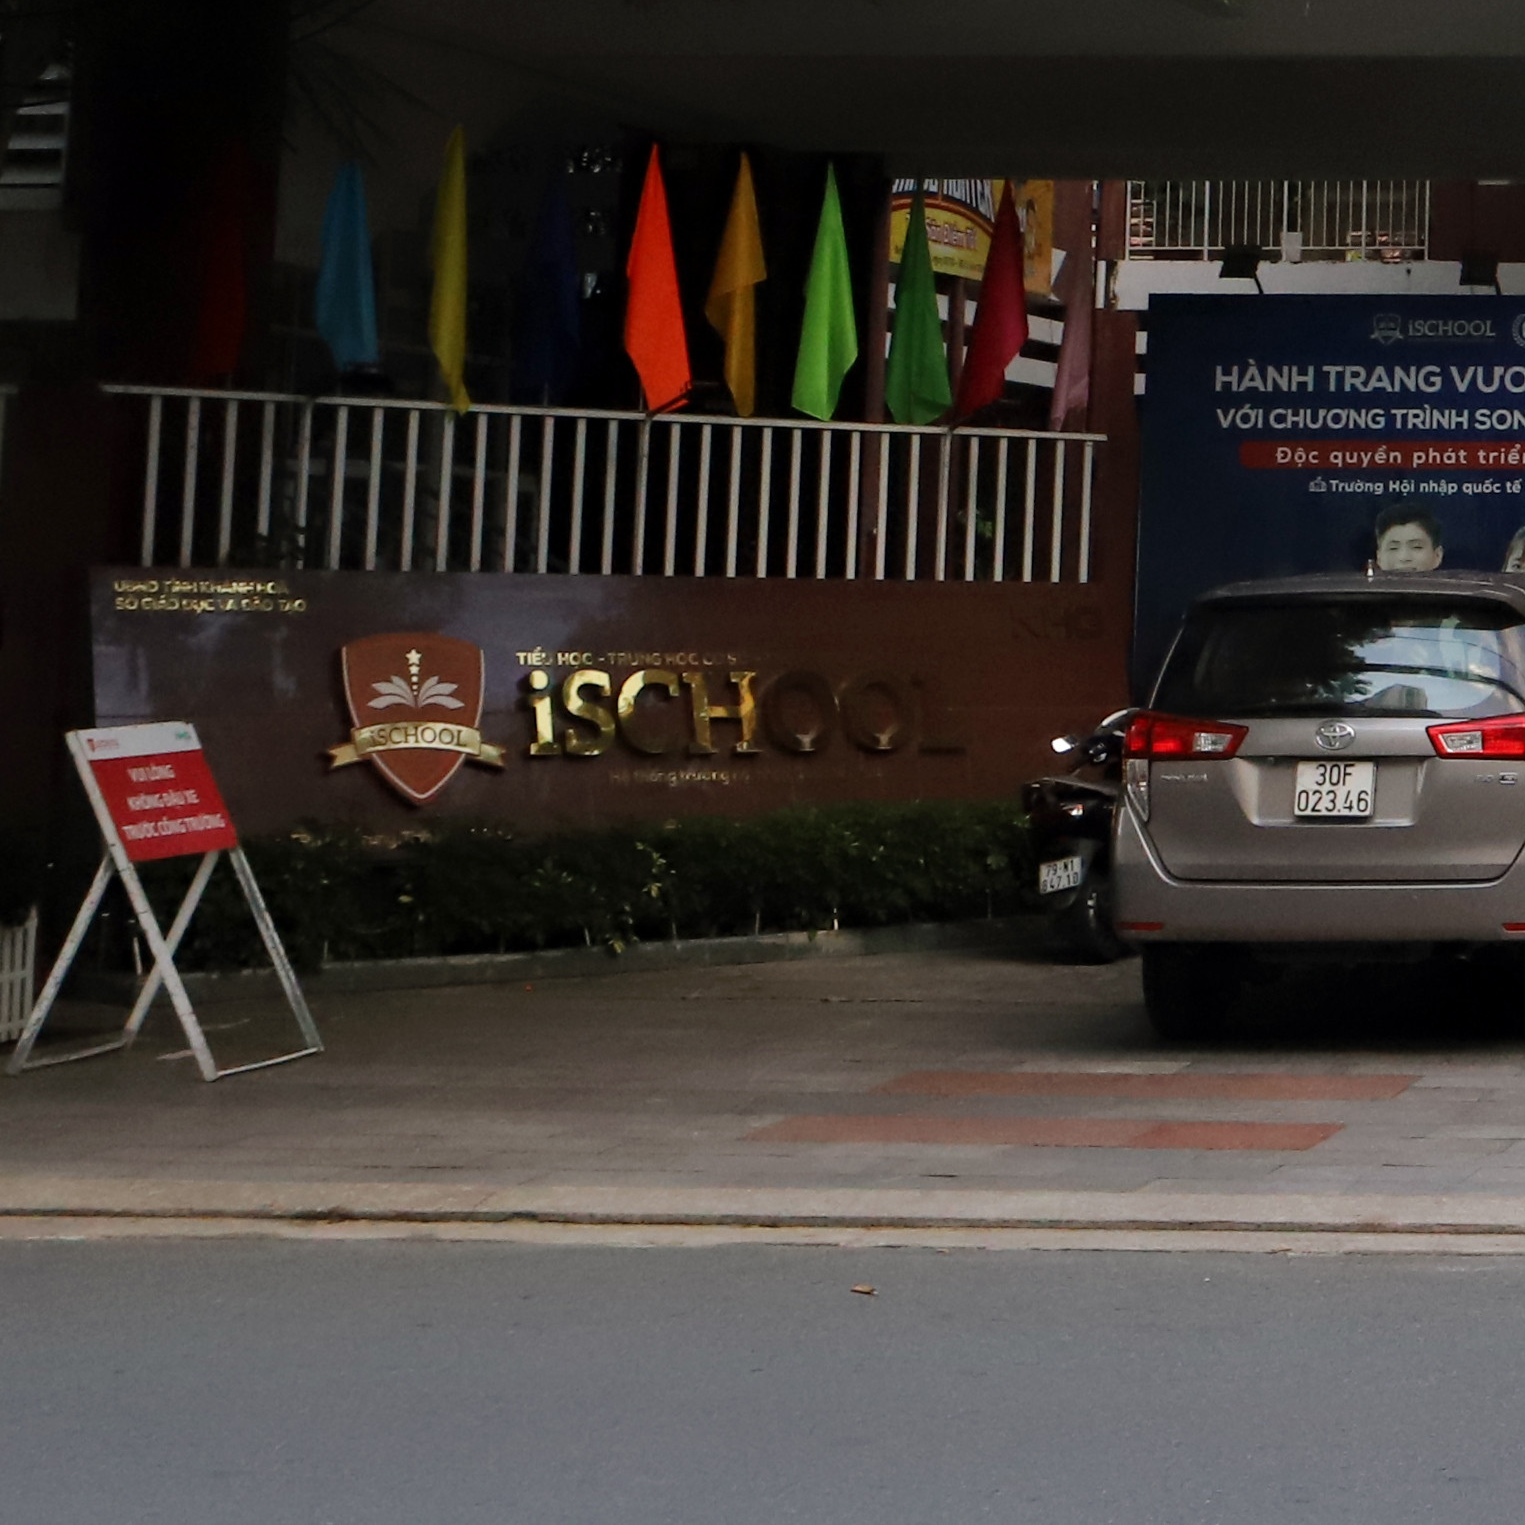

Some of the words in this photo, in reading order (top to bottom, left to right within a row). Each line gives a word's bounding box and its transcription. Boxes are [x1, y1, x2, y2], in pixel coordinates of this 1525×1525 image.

[1407, 319, 1496, 338] iSCHOOL
[1214, 359, 1315, 393] HÀNH
[1321, 365, 1443, 393] TRANG
[1216, 403, 1264, 430] VỚI
[1269, 407, 1386, 430] CHƯƠNG
[1390, 404, 1469, 430] TRÌNH
[1276, 446, 1320, 468] Độc
[1412, 447, 1468, 469] phát
[1329, 479, 1384, 495] Trường
[1388, 479, 1416, 496] Hội
[1419, 480, 1458, 496] nhập
[1462, 479, 1502, 496] quốc
[1505, 478, 1523, 494] tế
[369, 726, 467, 747] iSCHOOL
[1315, 763, 1356, 787] 30F
[1297, 789, 1369, 813] 023.46
